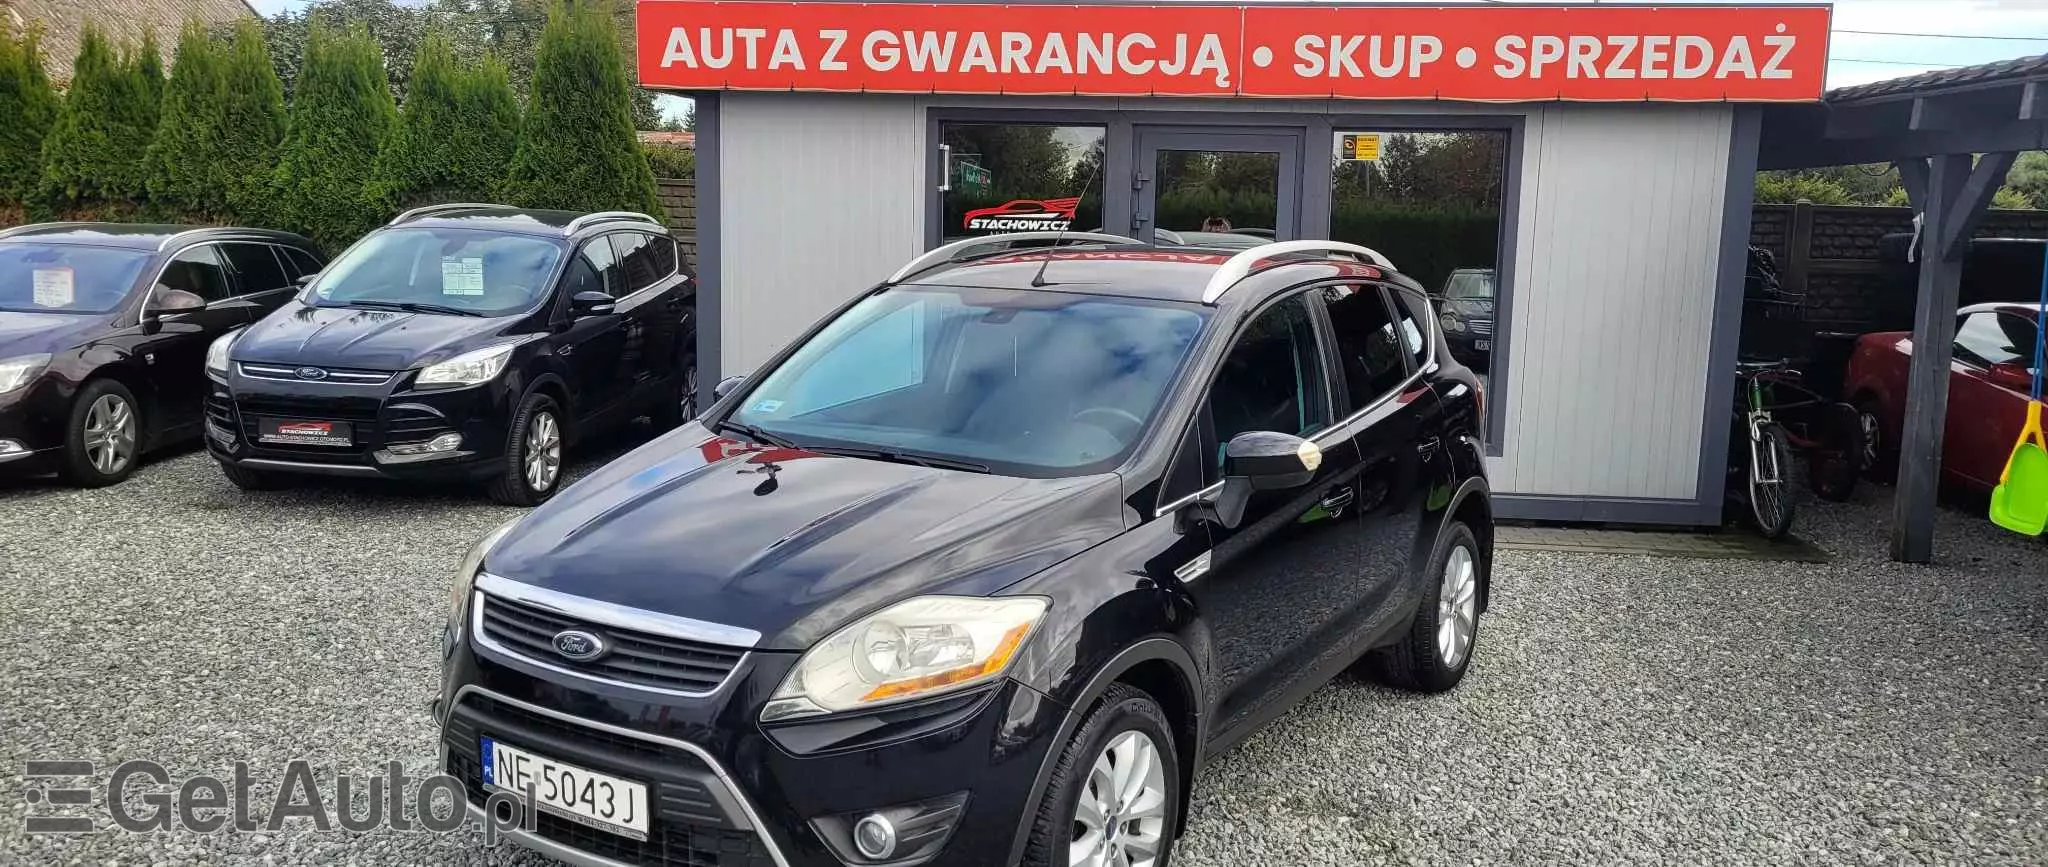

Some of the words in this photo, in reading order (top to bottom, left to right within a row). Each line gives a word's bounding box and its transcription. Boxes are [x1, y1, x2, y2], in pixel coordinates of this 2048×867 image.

[660, 28, 806, 71] AUTA
[819, 29, 848, 71] Z
[861, 30, 1231, 88] GWARANCJĄ
[1293, 34, 1443, 78] SKUP
[1493, 22, 1797, 79] SPRZEDAŻ
[969, 219, 1071, 231] STACHOWICZ
[561, 635, 588, 652] Ford
[484, 765, 494, 778] PL
[498, 748, 531, 792] NE
[543, 764, 635, 824] 5043J
